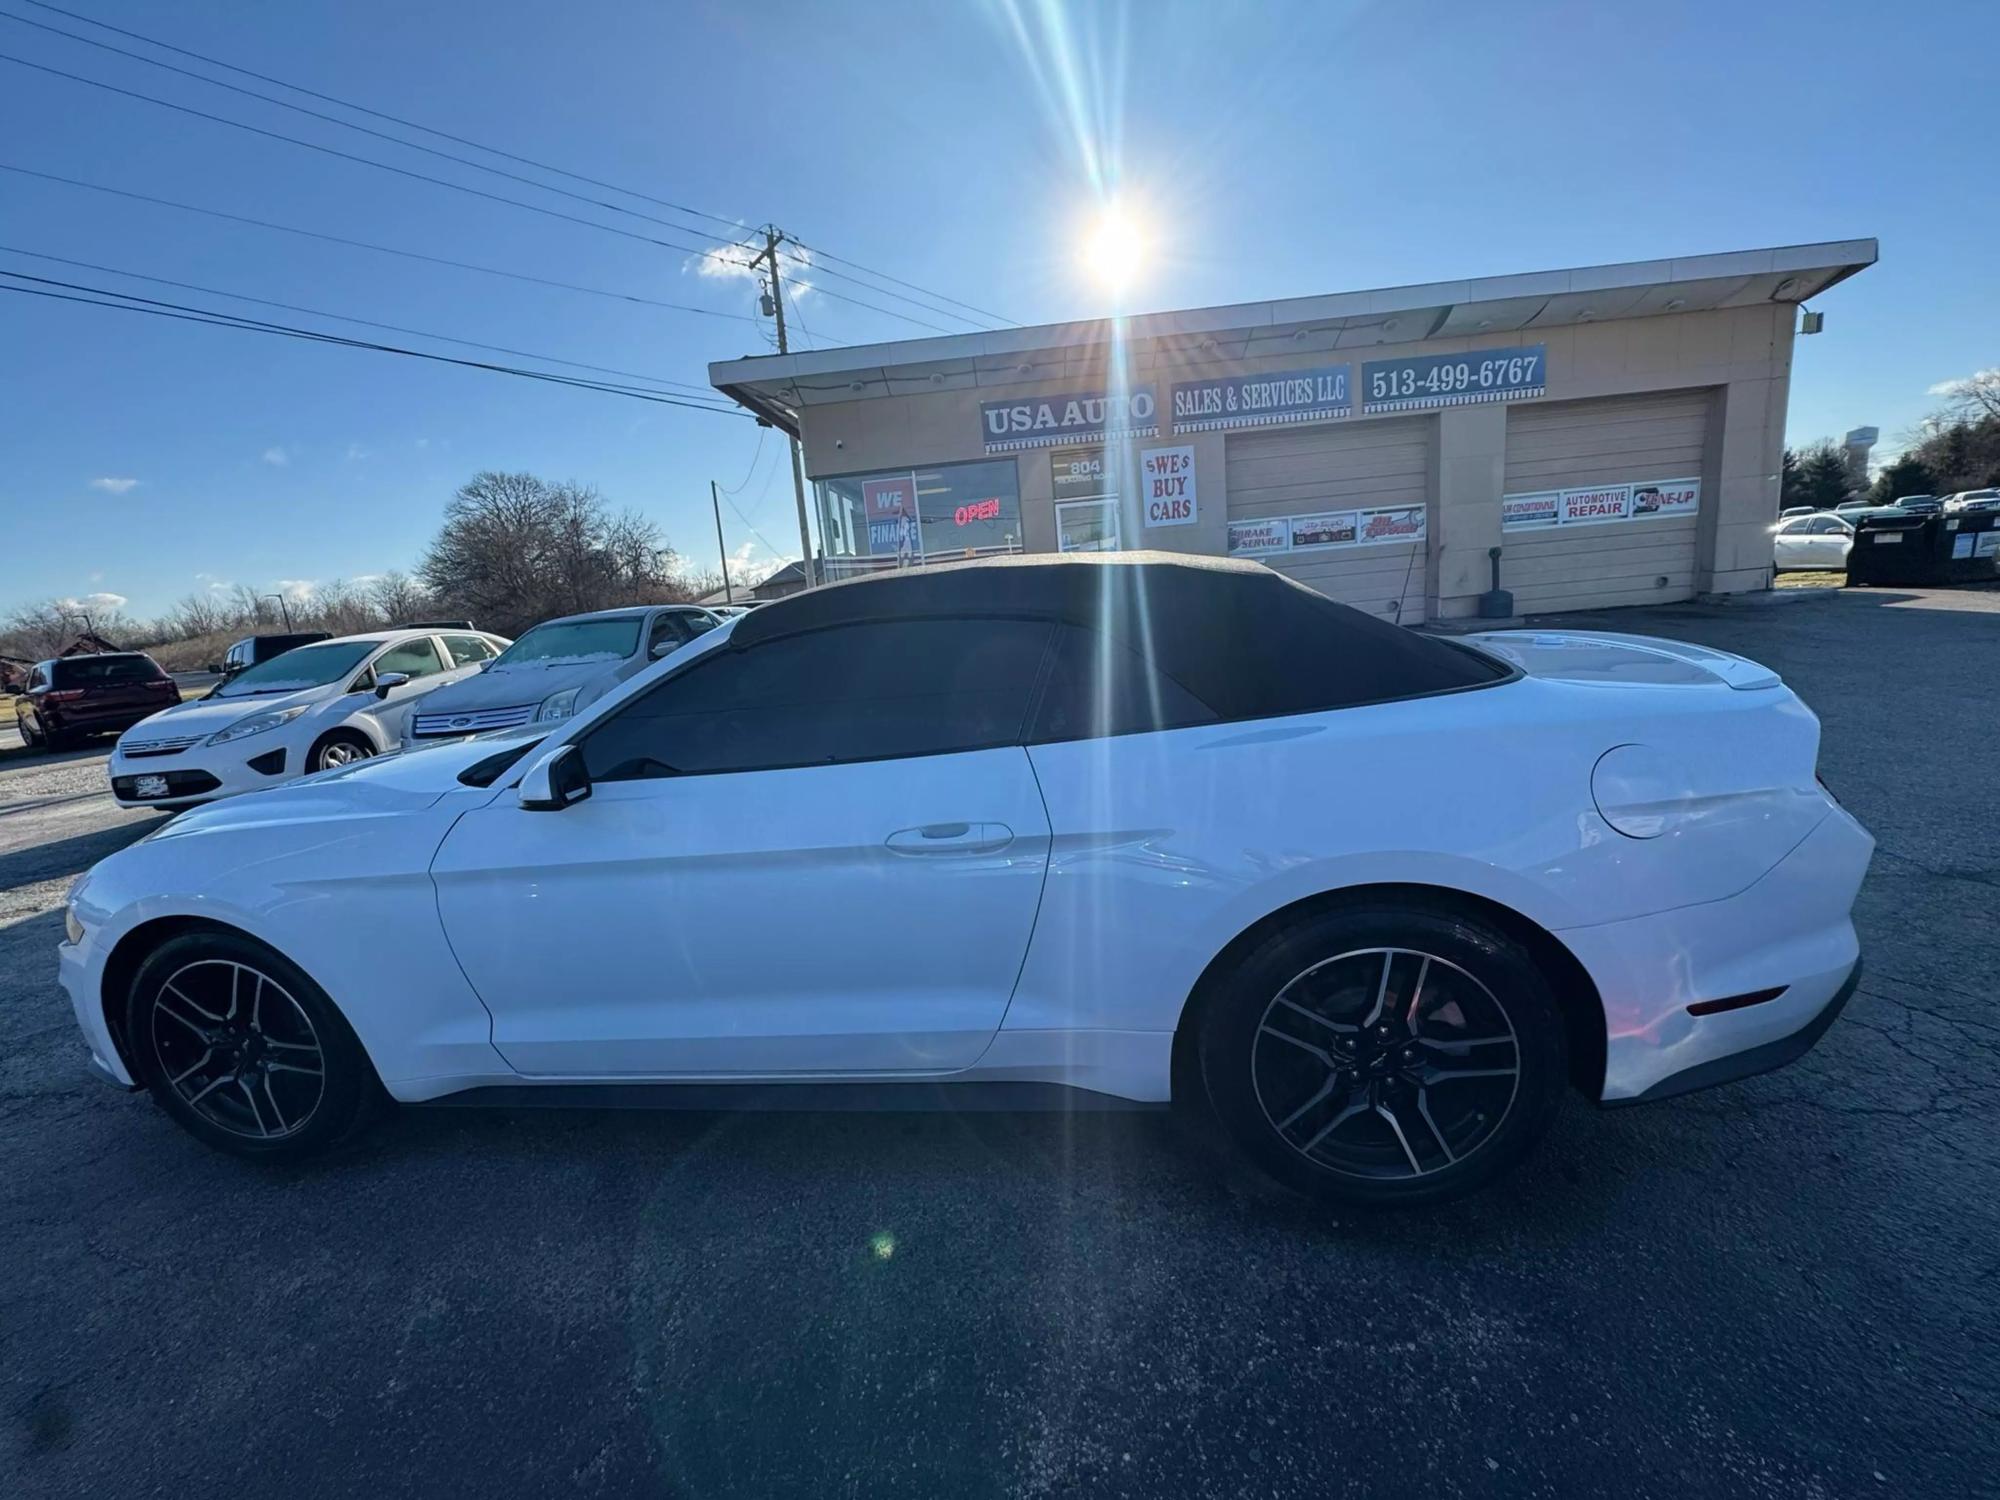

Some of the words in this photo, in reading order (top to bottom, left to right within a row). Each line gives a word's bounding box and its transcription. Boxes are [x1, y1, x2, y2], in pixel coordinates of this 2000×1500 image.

[1372, 355, 1539, 399] 513-499-6767
[1175, 388, 1222, 417] SALES
[1226, 386, 1238, 411] &
[1242, 377, 1314, 410] SERVICES
[1316, 374, 1345, 402] LLC
[985, 404, 1058, 434] USA
[1061, 392, 1154, 427] AUTO
[1071, 459, 1101, 475] 804
[1155, 454, 1180, 475] WE
[1153, 477, 1188, 498] BUY
[876, 490, 903, 509] WE
[1566, 490, 1627, 507] AUTOMOTIVE
[954, 498, 999, 527] OPEN
[1150, 499, 1191, 521] CARS
[1568, 502, 1623, 518] REPAIR
[1238, 527, 1273, 540] BRAKE
[1241, 536, 1284, 549] SERVICE
